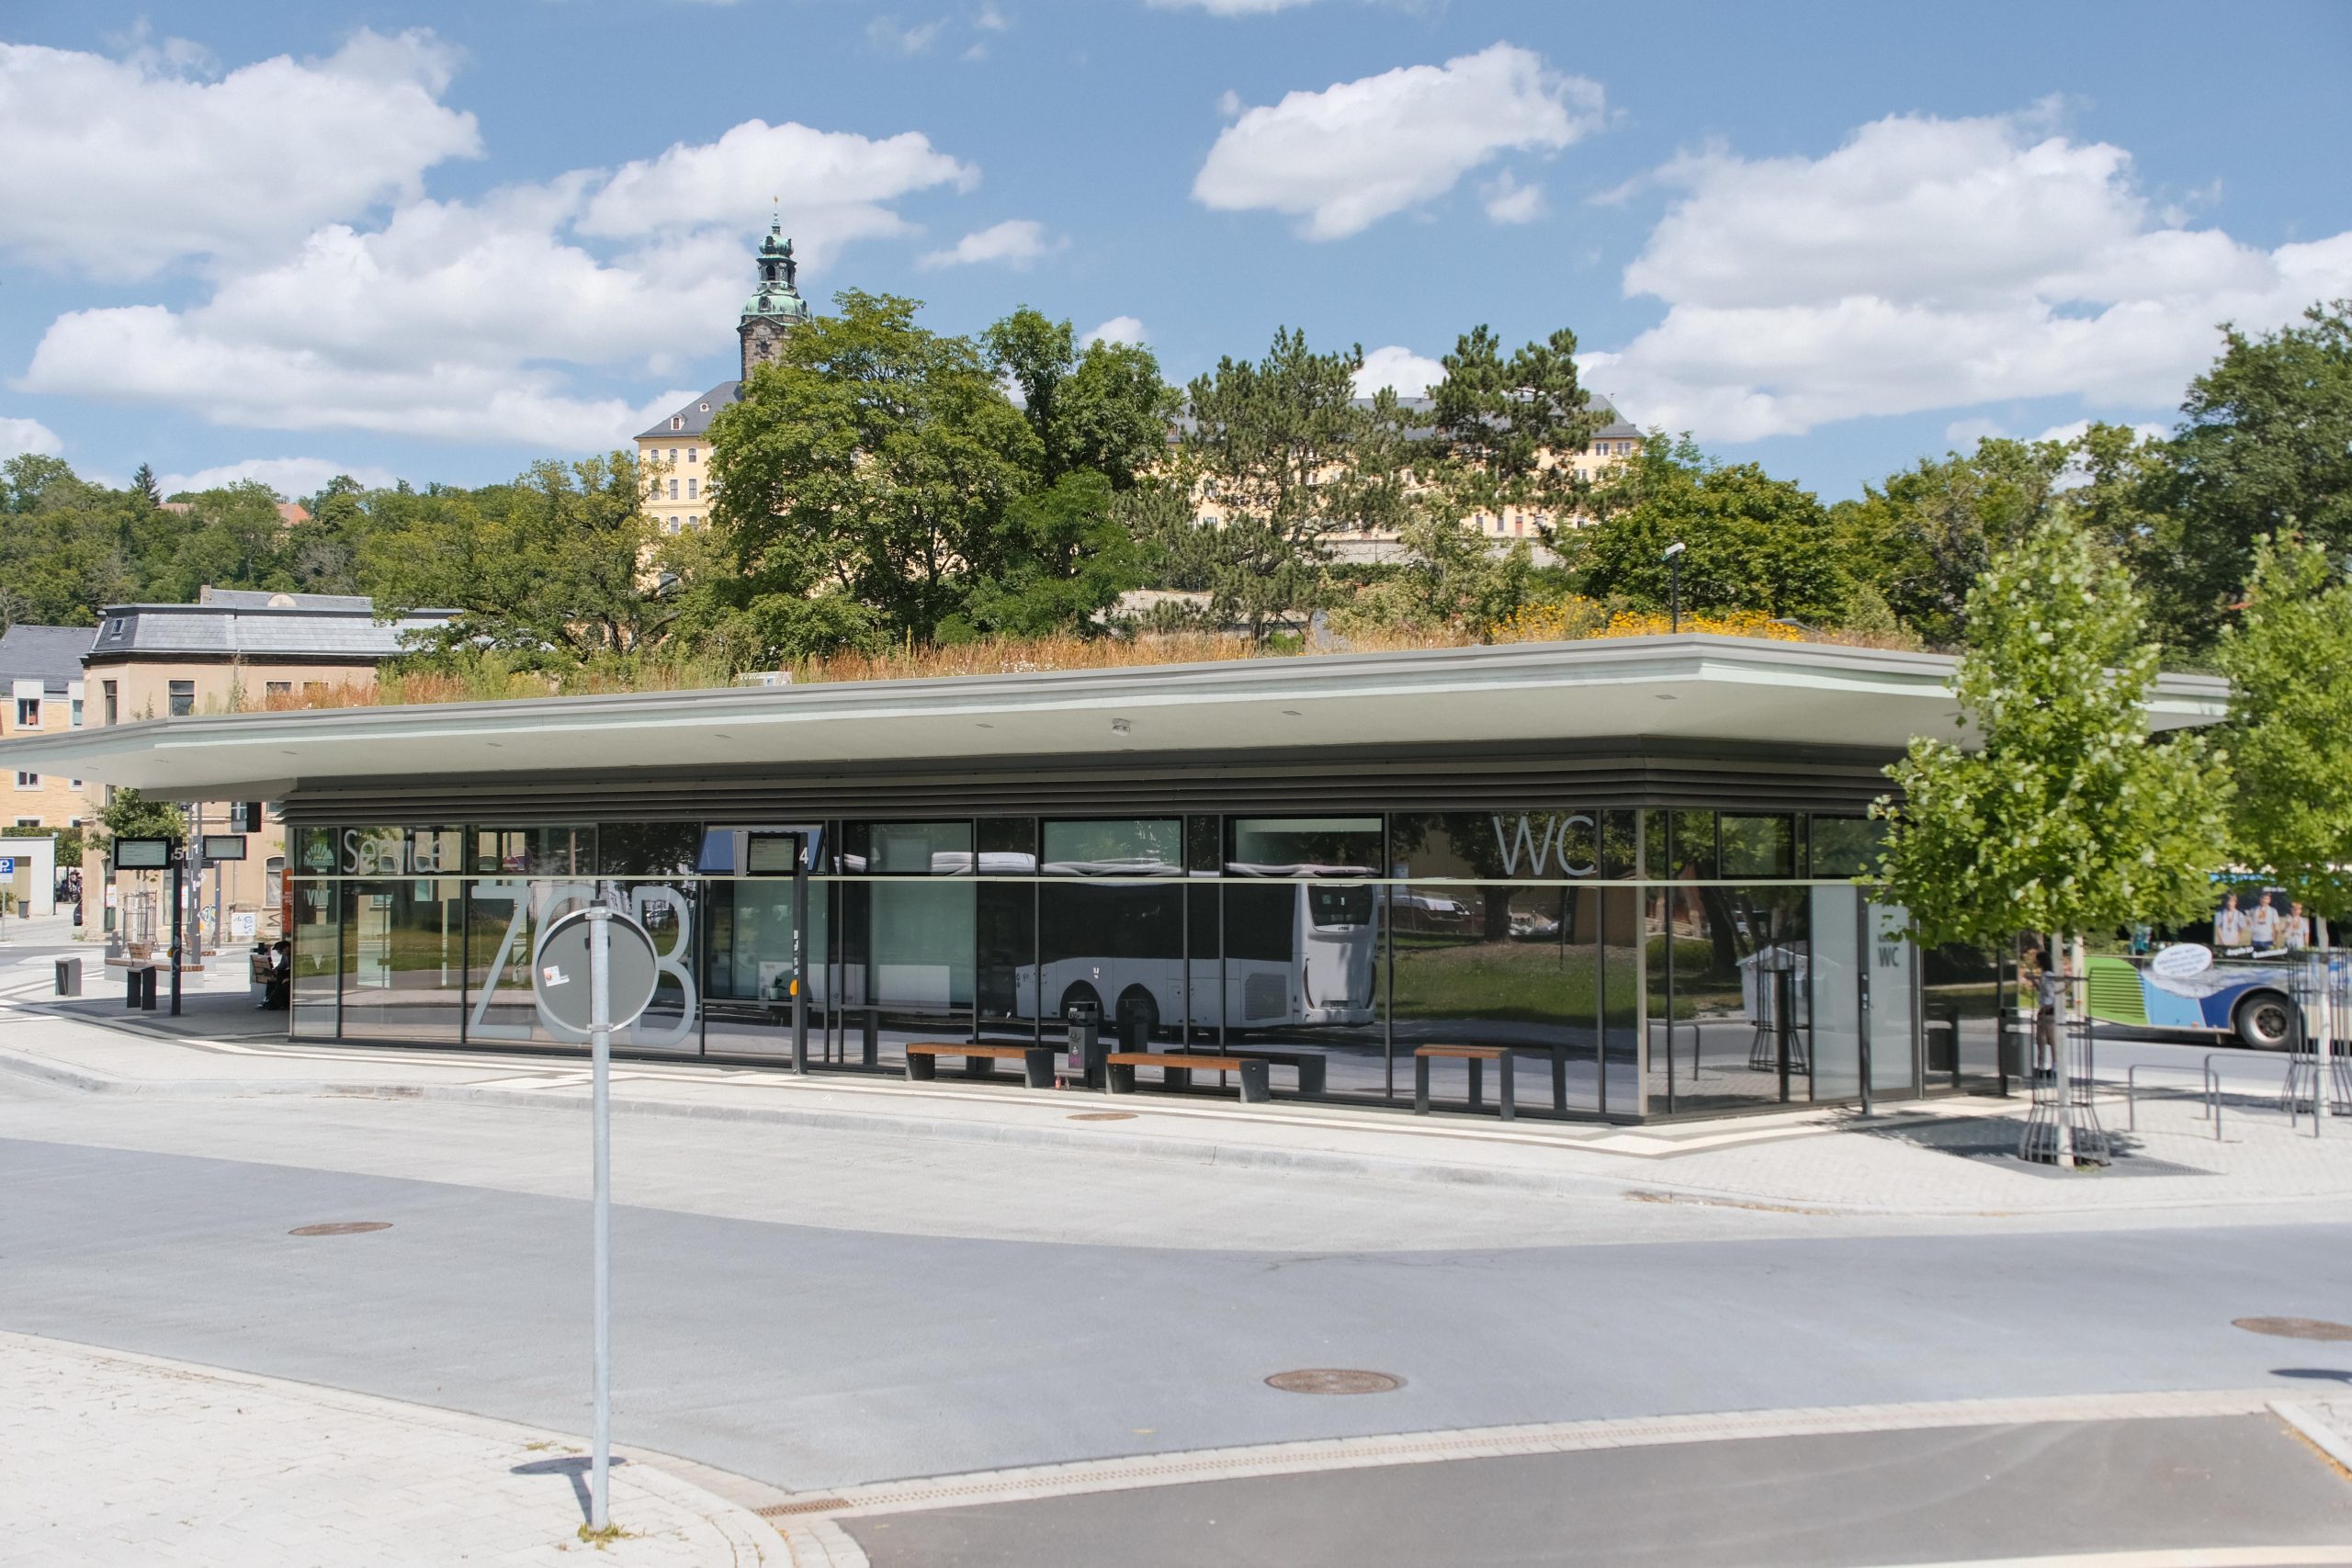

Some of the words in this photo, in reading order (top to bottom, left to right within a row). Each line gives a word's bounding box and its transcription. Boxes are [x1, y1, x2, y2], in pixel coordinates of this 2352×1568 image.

[174, 847, 183, 861] 5
[343, 829, 448, 873] Service
[1493, 815, 1594, 875] WC
[798, 847, 808, 863] 4
[306, 889, 331, 906] VMT
[1878, 946, 1899, 967] WC
